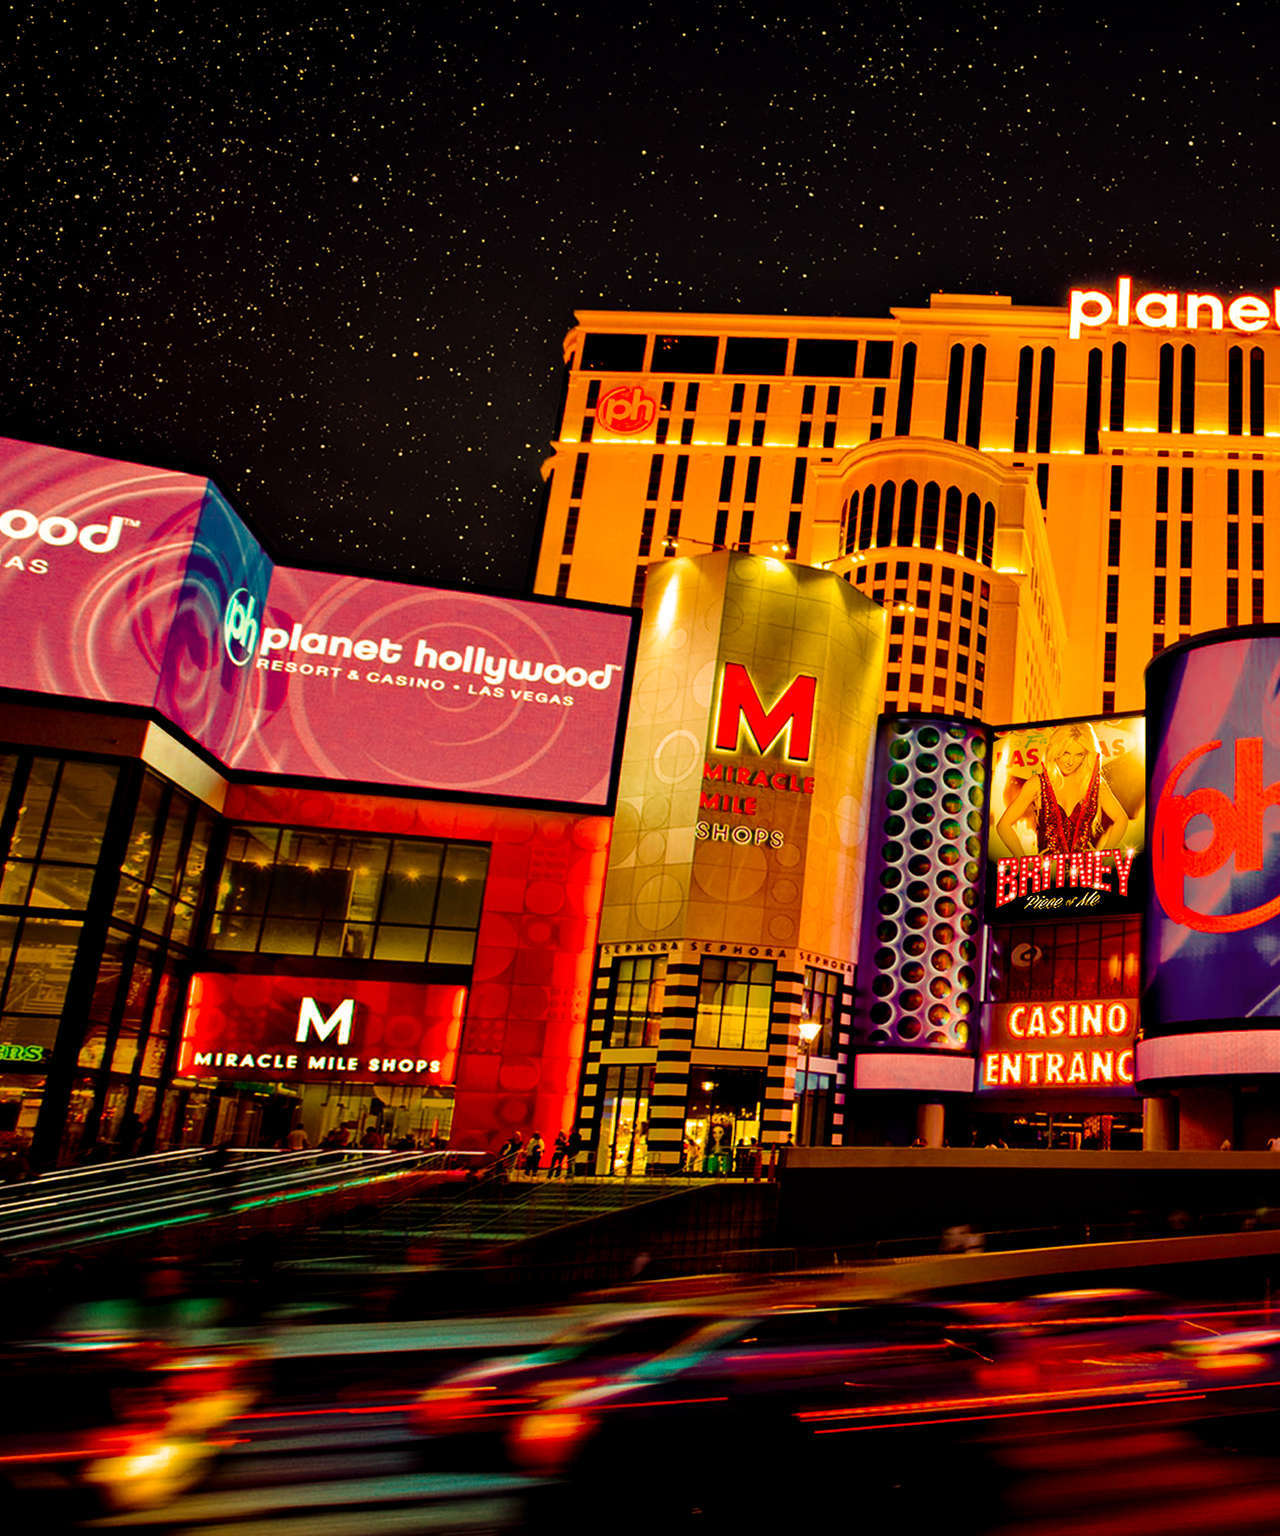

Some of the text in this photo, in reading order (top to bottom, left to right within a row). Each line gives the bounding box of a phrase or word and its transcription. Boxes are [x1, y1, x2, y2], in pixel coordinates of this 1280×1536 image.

[605, 388, 654, 427] ph
[260, 623, 403, 664] planet
[256, 658, 574, 706] RESORT & CASINO LAS VEGAS
[714, 661, 818, 762] M
[703, 762, 815, 795] MIRACLE
[700, 792, 757, 816] MILE
[695, 820, 784, 849] SHOPS
[995, 848, 1134, 908] BRITNEY
[1024, 894, 1063, 909] Piece
[1076, 891, 1100, 907] Me
[604, 942, 678, 954] SEPHORA
[691, 942, 787, 958] SEPHORA
[800, 951, 852, 972] SEPHORA
[296, 997, 354, 1045] M
[1009, 1003, 1127, 1036] CASINO
[194, 1053, 441, 1073] MIRACLE MILE SHOPS
[985, 1050, 1133, 1085] ENTRANC
